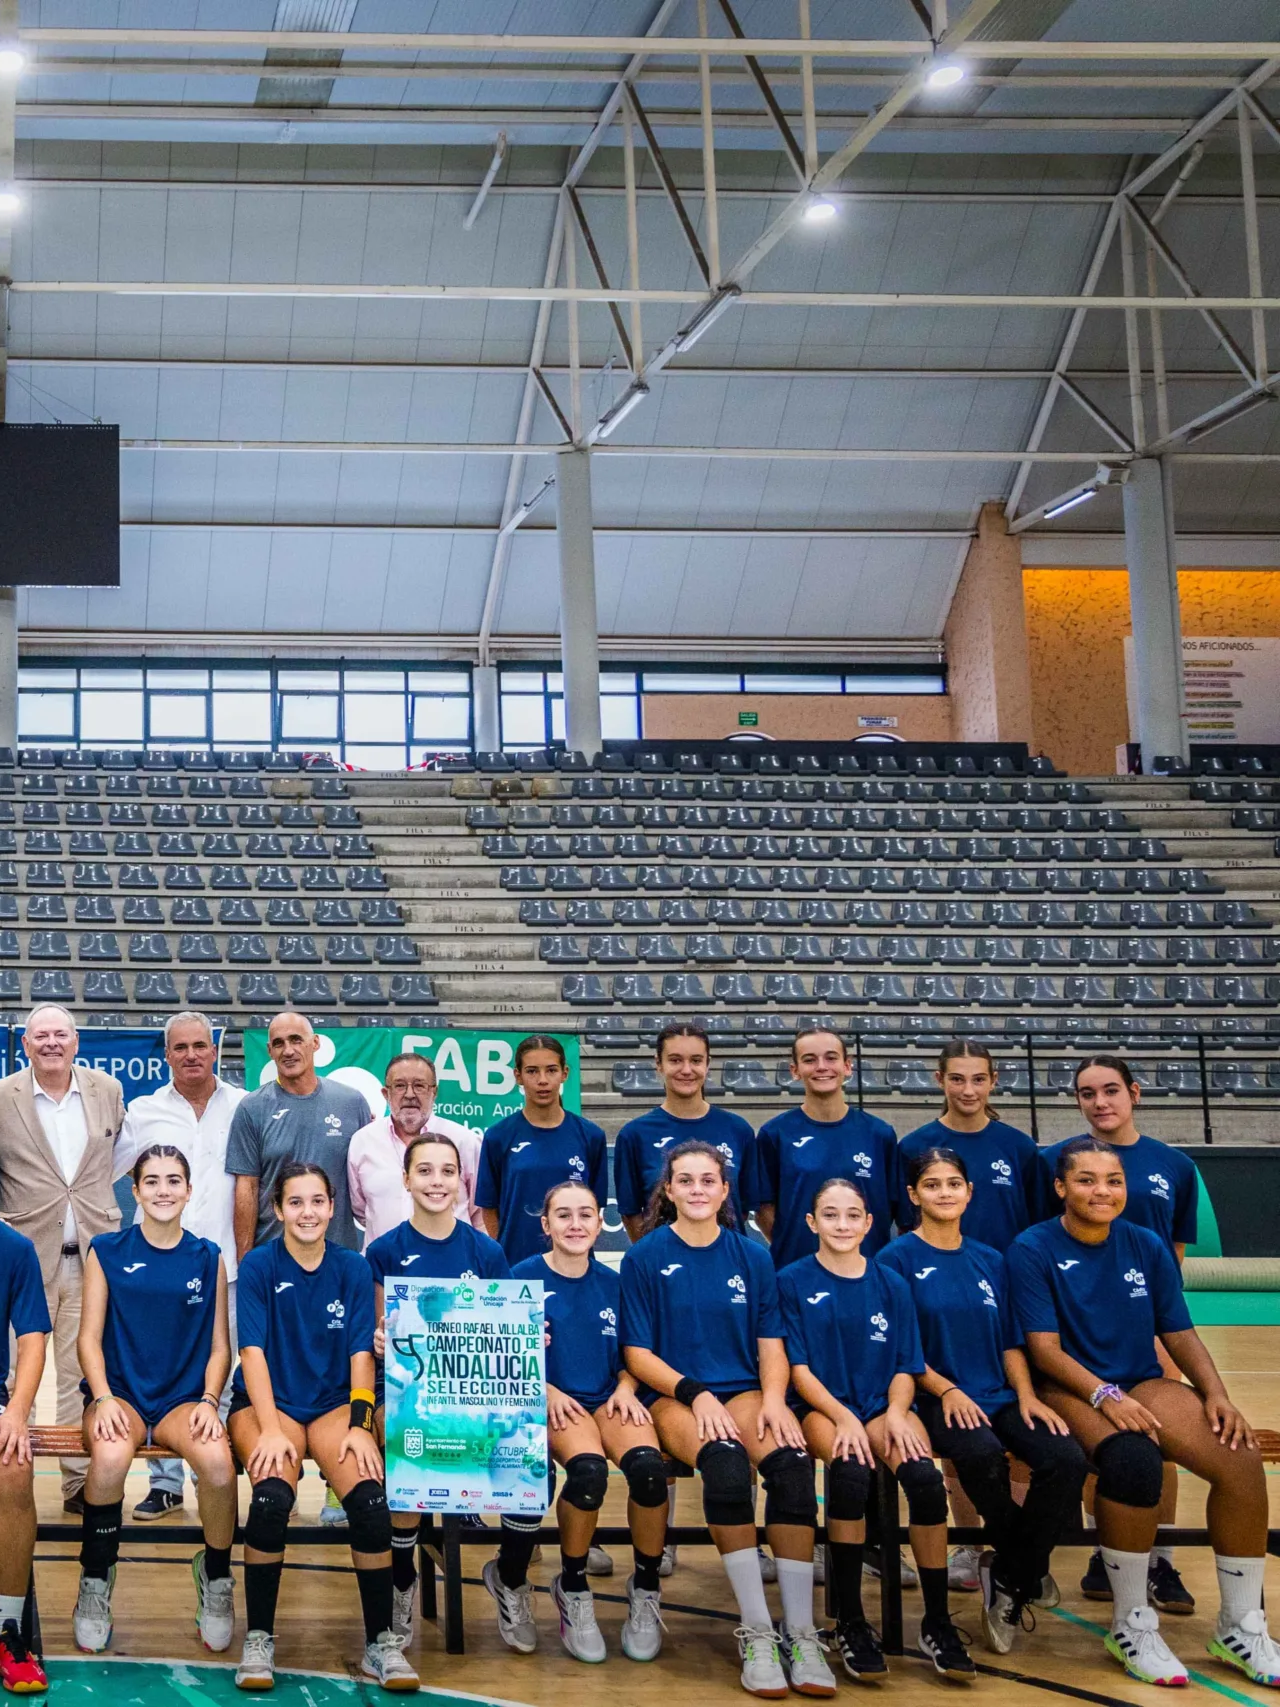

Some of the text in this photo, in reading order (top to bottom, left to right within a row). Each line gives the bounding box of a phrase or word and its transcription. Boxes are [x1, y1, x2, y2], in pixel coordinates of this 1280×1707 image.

[432, 1101, 483, 1116] eración
[426, 1322, 540, 1335] TORNEO RAFAEL VILLALBA
[426, 1335, 540, 1354] CAMPEONATO DE
[427, 1351, 540, 1380] ANDALUCÍA
[427, 1380, 541, 1396] SELECCIONES
[426, 1396, 540, 1407] INFANTIL MASCULINO Y FEMENINO
[492, 1447, 528, 1456] OCTUBRE
